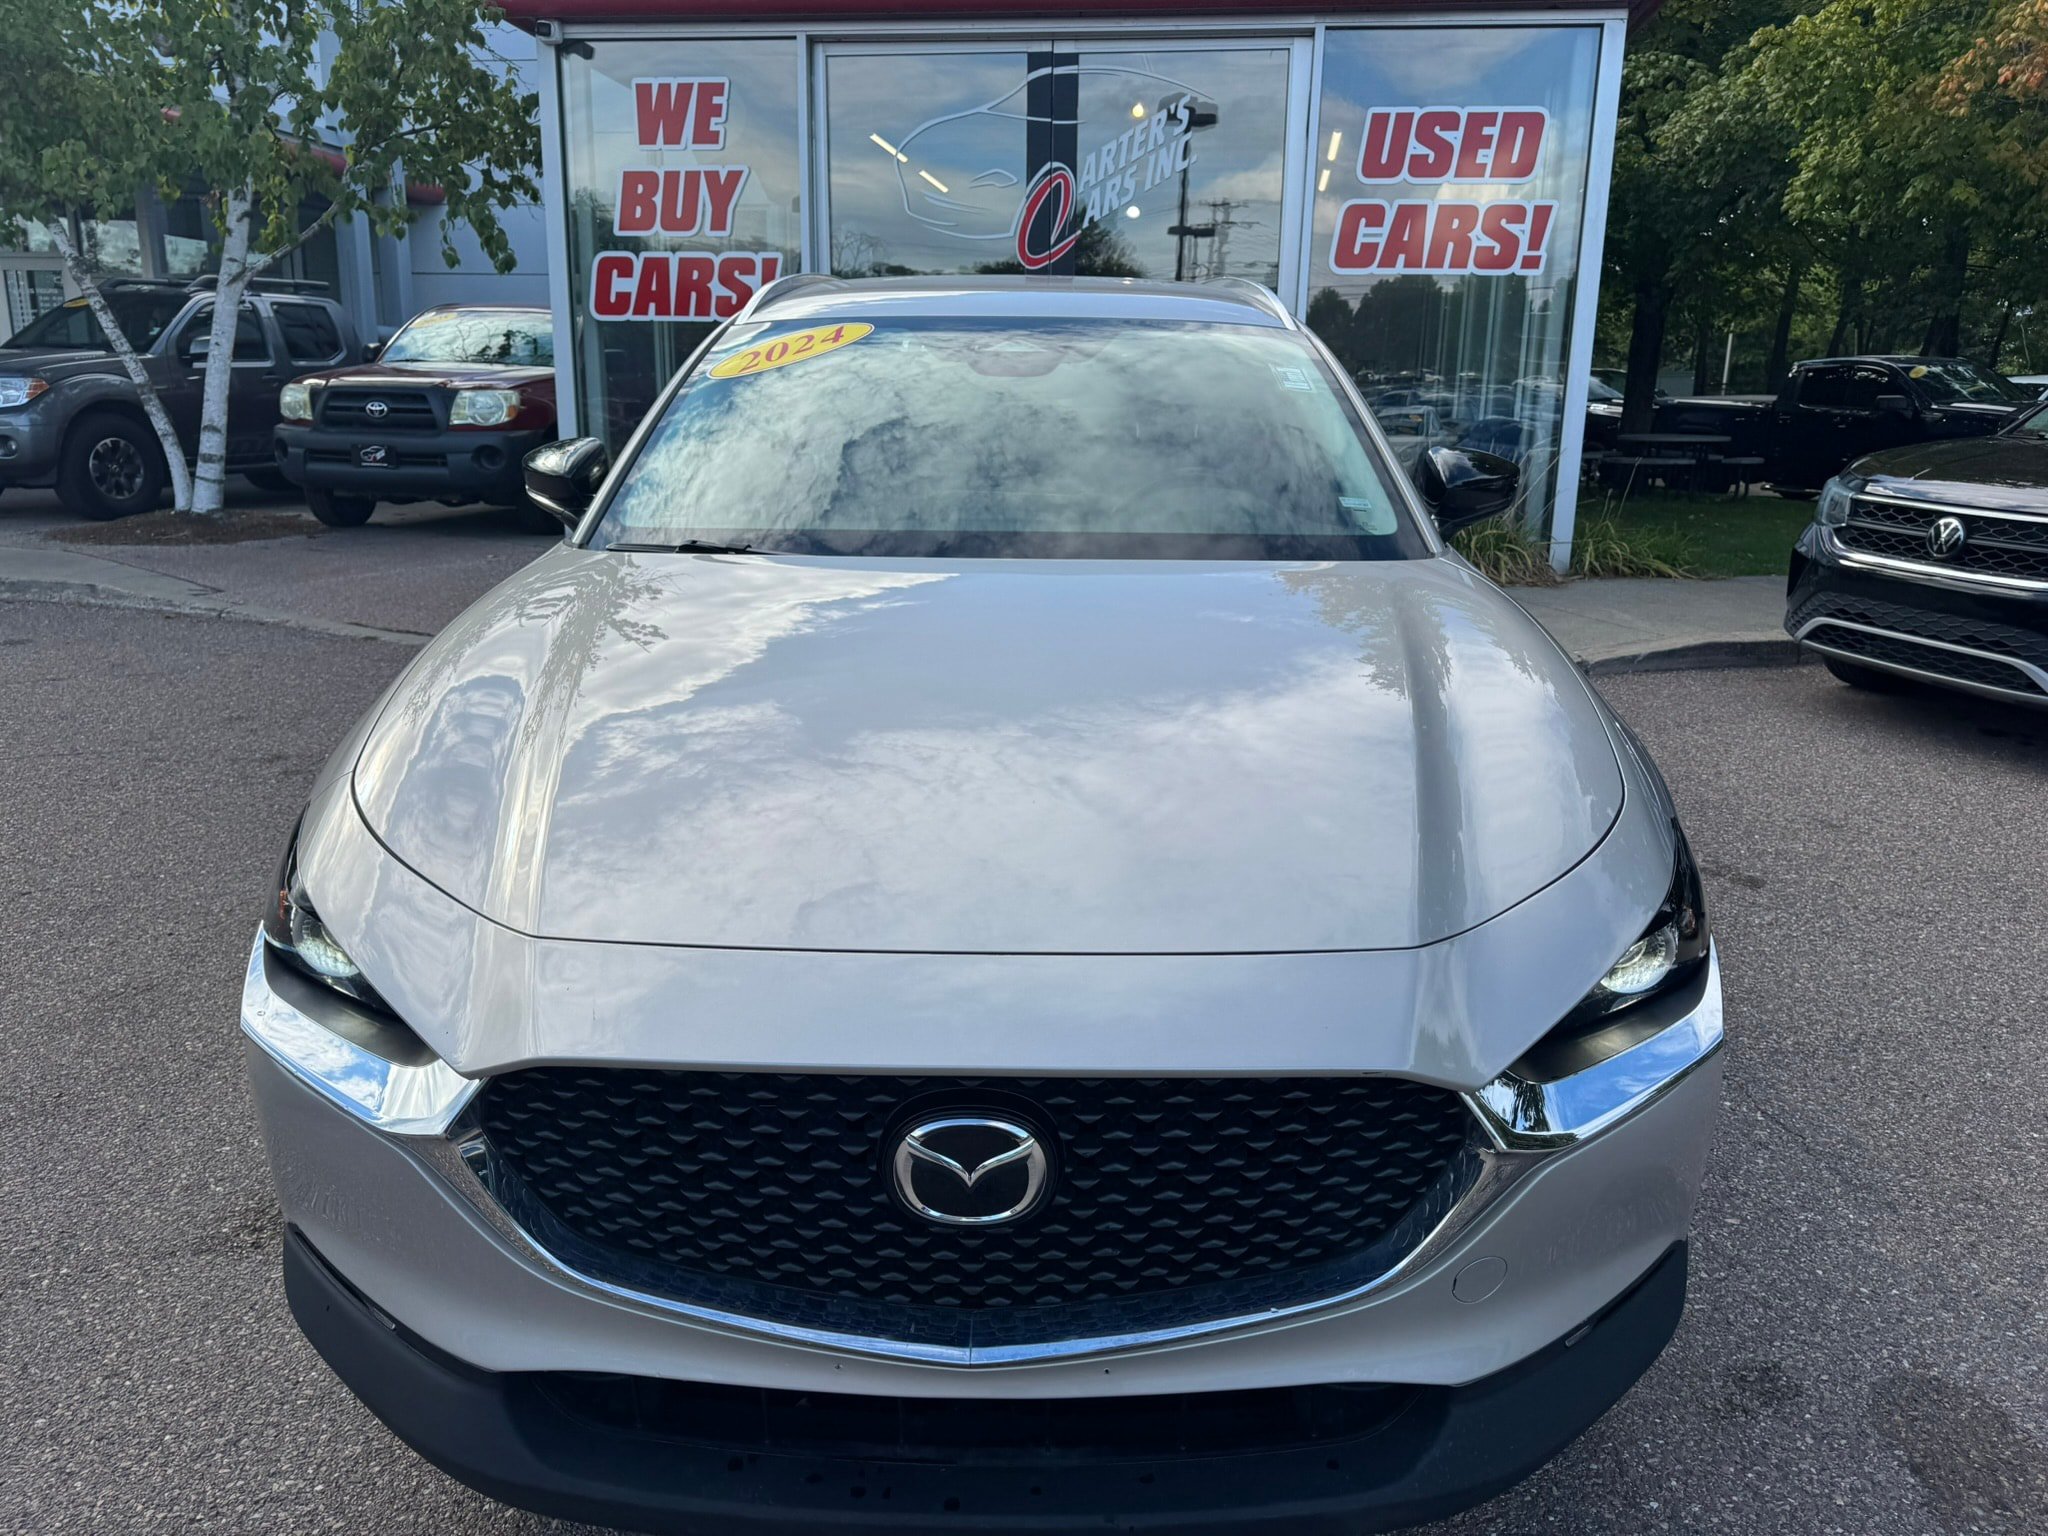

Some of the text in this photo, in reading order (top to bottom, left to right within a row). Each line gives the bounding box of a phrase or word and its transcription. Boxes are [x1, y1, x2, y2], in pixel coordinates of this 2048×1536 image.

[633, 80, 727, 148] WE
[1359, 109, 1548, 181] USED
[616, 168, 747, 234] BUY
[1331, 202, 1556, 272] CARS!
[737, 325, 845, 374] 2024
